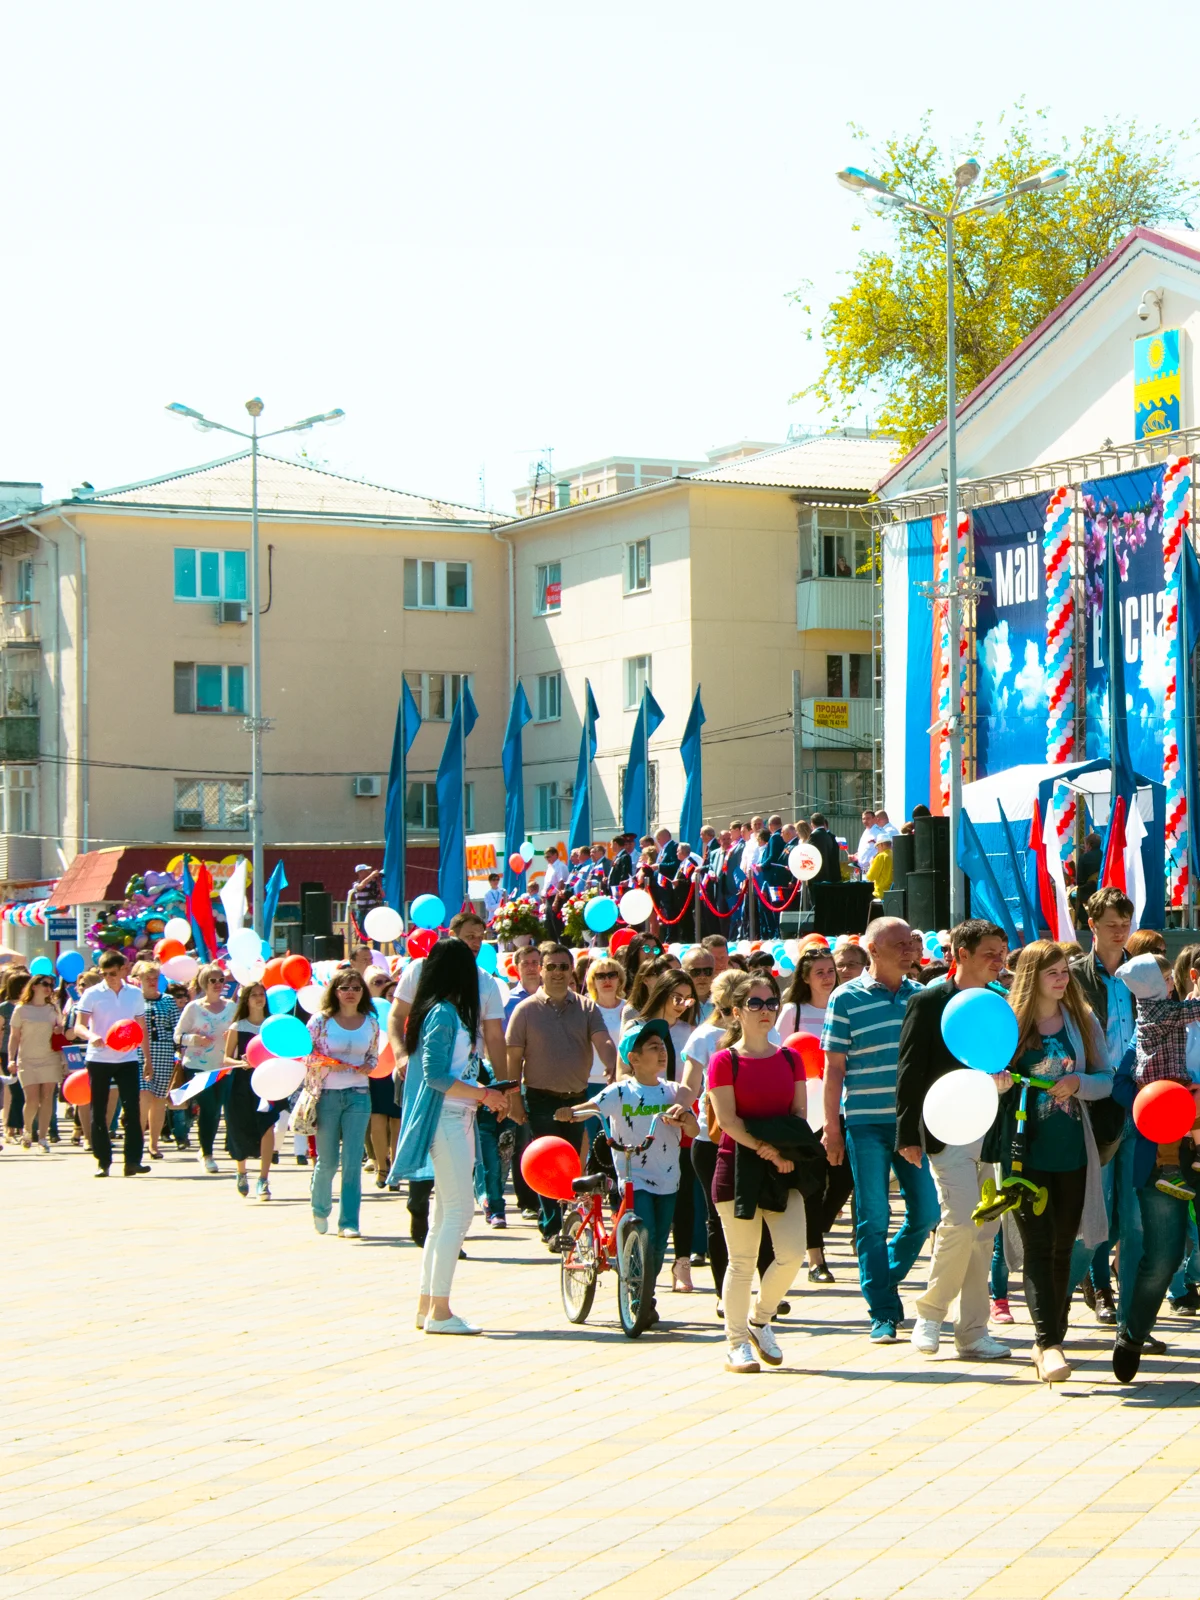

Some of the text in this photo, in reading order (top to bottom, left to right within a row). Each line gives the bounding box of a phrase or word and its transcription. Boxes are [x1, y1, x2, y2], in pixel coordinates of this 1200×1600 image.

[995, 530, 1038, 607] май
[1092, 589, 1169, 668] всна
[816, 704, 847, 715] ПРОДАМ
